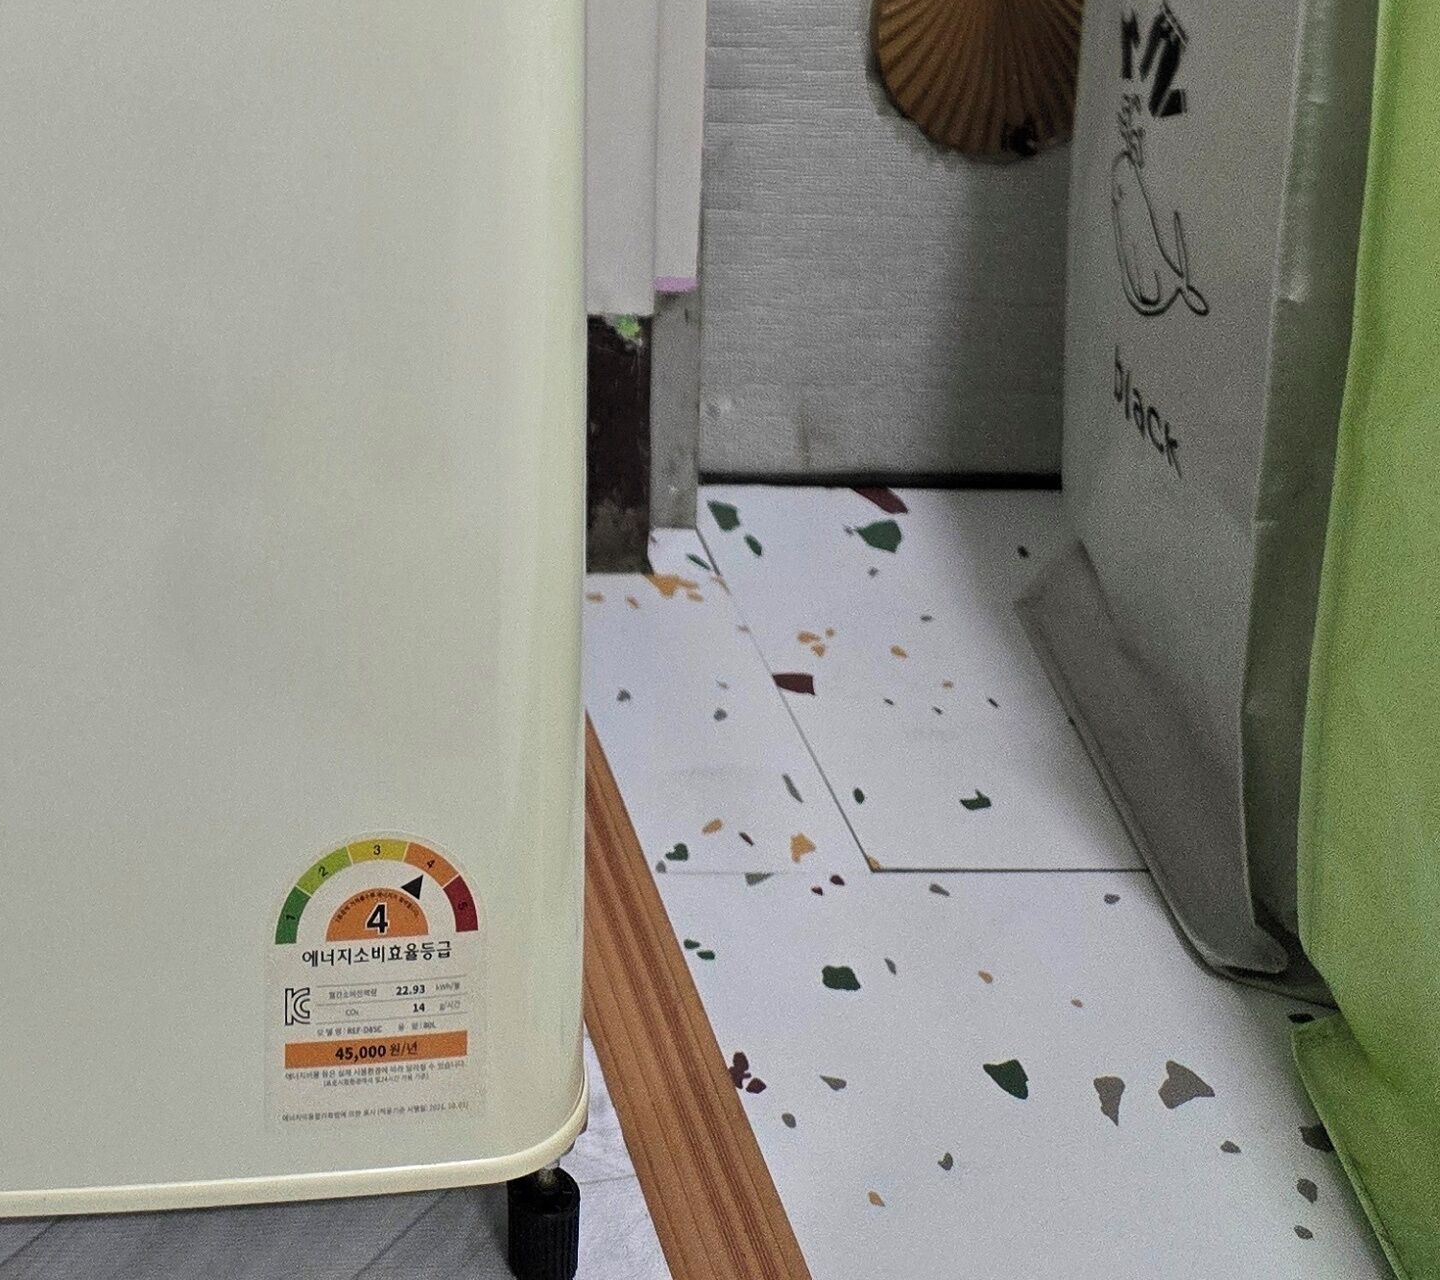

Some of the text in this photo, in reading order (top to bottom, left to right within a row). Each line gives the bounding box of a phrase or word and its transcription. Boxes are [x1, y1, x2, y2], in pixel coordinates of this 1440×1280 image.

[1114, 344, 1182, 480] black
[372, 844, 382, 857] 3
[425, 858, 437, 870] 4
[317, 865, 330, 878] 2
[365, 902, 390, 935] 4
[301, 940, 453, 968] 에너지소비효율등급
[395, 984, 426, 996] 22.93
[412, 1002, 426, 1013] 14
[335, 1042, 418, 1062] 45,000 원/년
